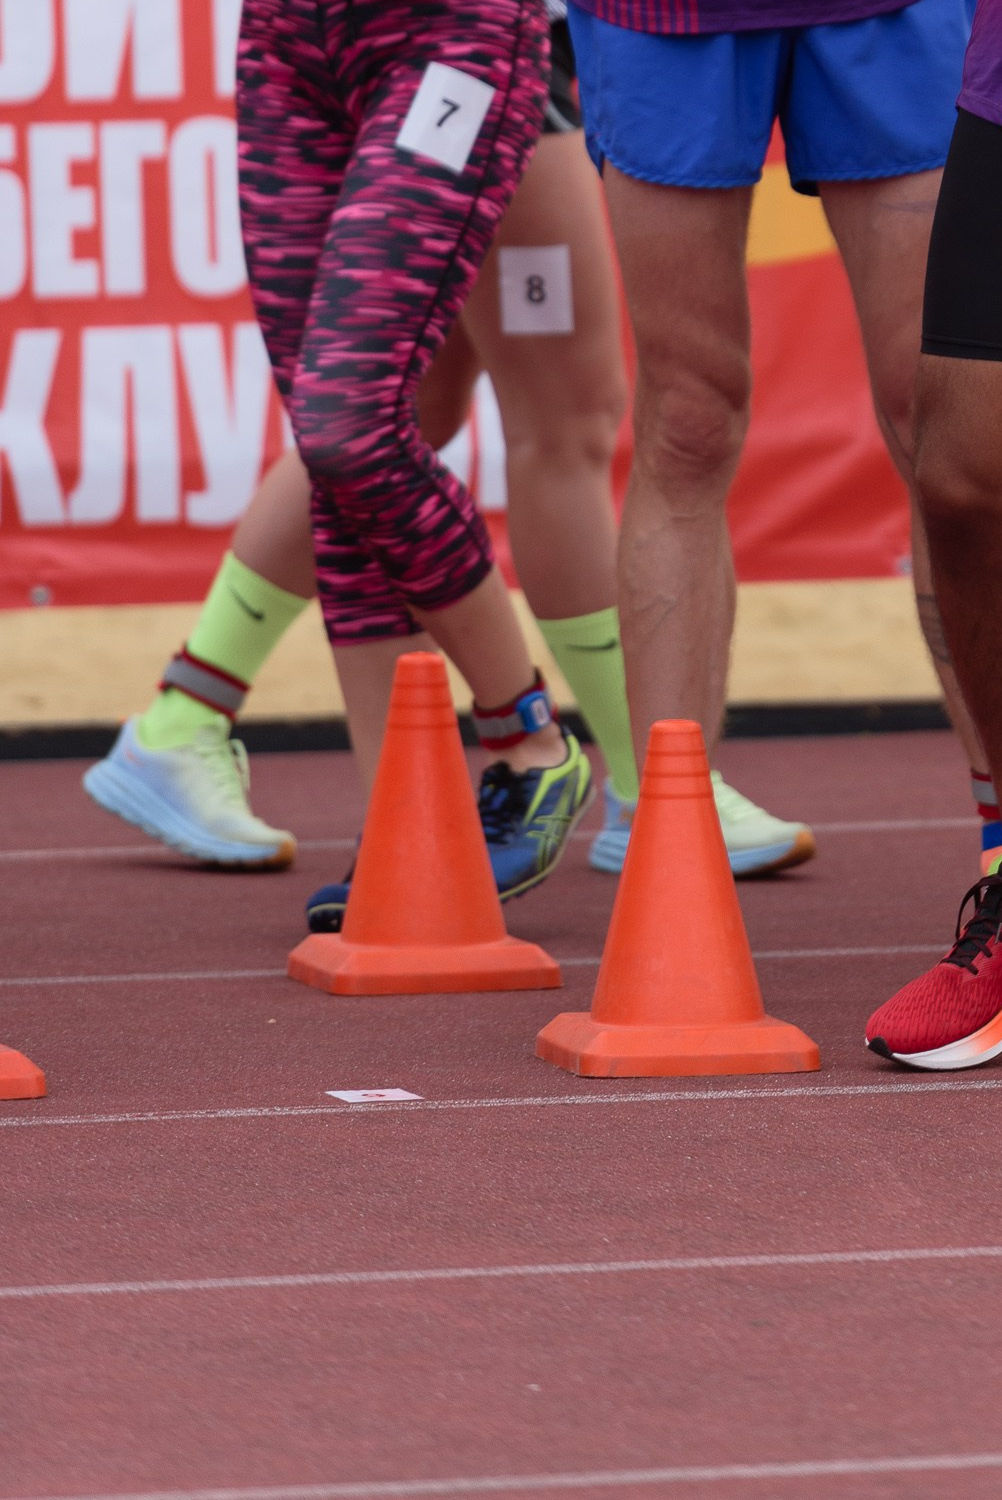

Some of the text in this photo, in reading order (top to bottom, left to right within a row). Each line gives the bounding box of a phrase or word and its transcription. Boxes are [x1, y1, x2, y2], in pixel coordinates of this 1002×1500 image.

[436, 97, 461, 128] 7
[0, 115, 249, 299] ЕГО
[526, 273, 547, 304] 8
[0, 322, 297, 529] КЛУ
